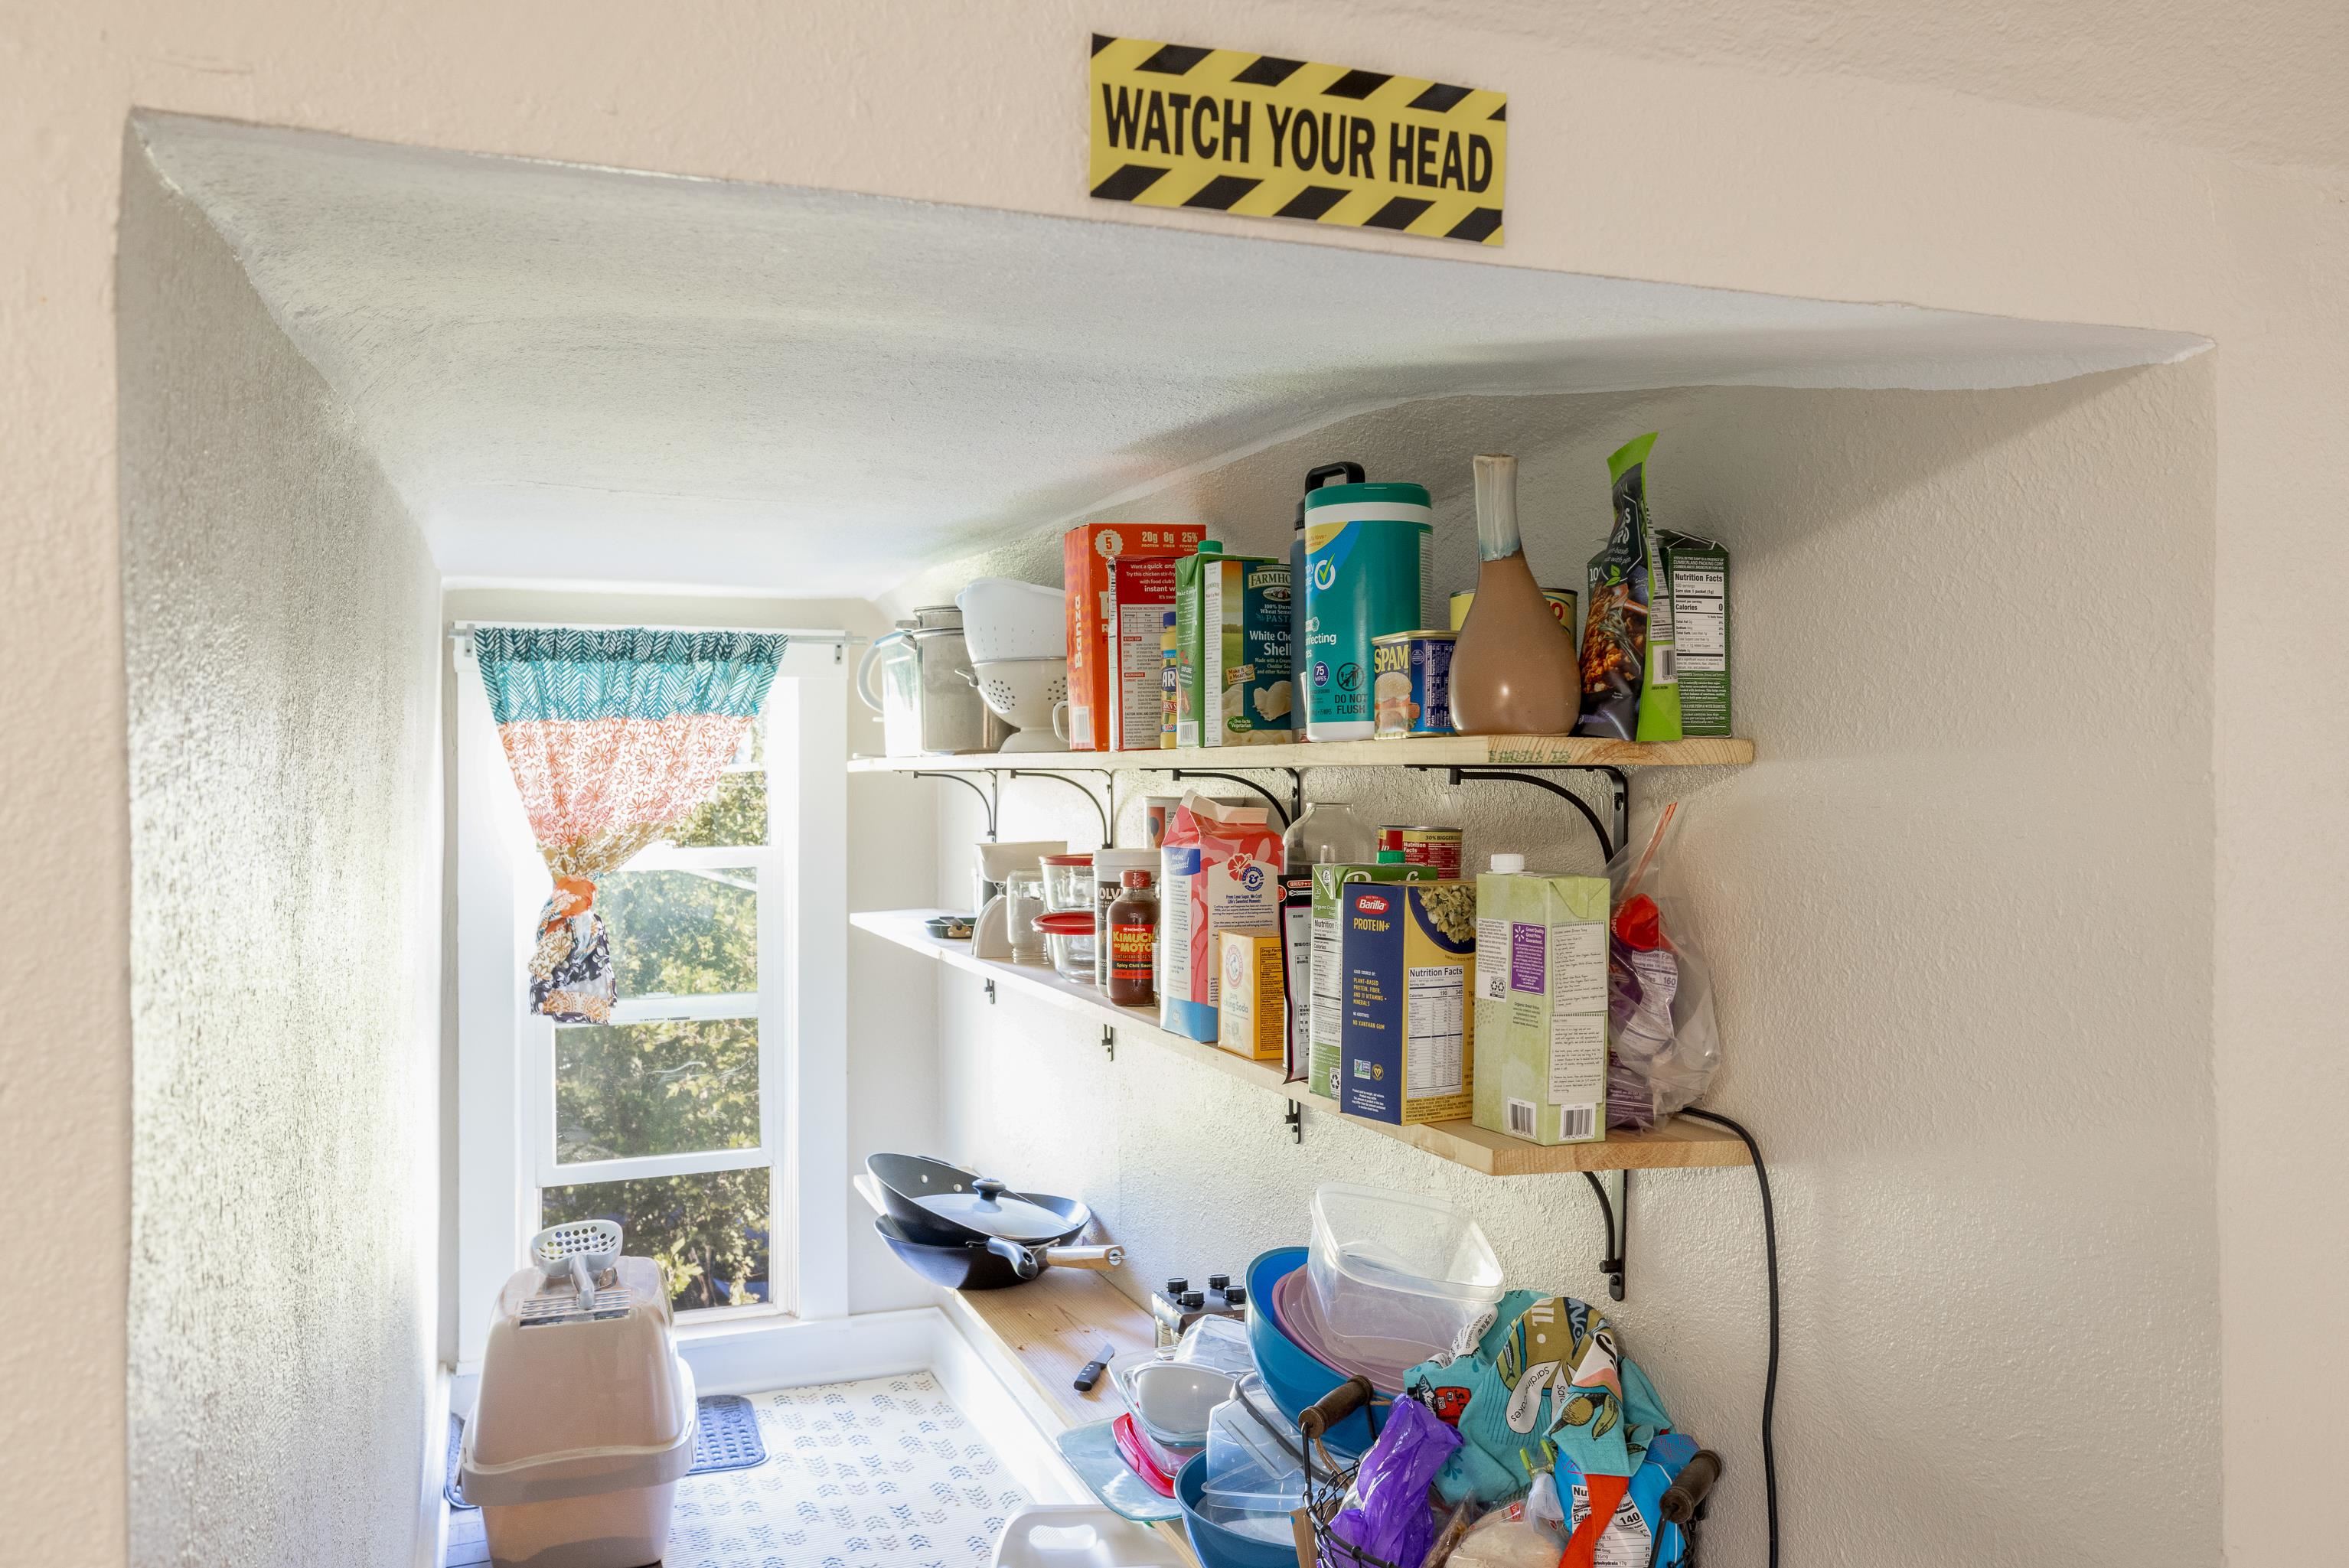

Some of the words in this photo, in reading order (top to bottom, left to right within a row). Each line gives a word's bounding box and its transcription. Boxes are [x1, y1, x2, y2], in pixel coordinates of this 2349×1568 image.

[1101, 82, 1251, 164] WATCH
[1266, 103, 1376, 180] YOUR
[1389, 122, 1493, 194] HEAD
[1105, 537, 1112, 549] 5
[1141, 531, 1159, 544] 20g
[1163, 531, 1174, 544] 8g
[1182, 532, 1198, 543] 25%
[1251, 572, 1291, 587] FARMHO
[1675, 573, 1704, 582] Nutrition
[1705, 574, 1723, 582] Facts
[1718, 603, 1724, 611] 0
[1075, 594, 1083, 669] Banza
[1249, 630, 1275, 641] White
[1264, 643, 1291, 656] Shell
[1374, 644, 1409, 673] SPAM
[1316, 665, 1325, 676] 75
[1162, 670, 1176, 687] AR
[1334, 693, 1346, 704] DO
[1349, 693, 1368, 703] NOT
[1336, 704, 1366, 715] FLUSH
[1248, 874, 1259, 885] &
[1359, 898, 1385, 911] Barilla
[1314, 919, 1335, 929] Nutrition
[1353, 918, 1390, 932] PROTEIN+
[1112, 931, 1154, 943] KIMUCH
[1120, 942, 1152, 953] MOTO
[1409, 968, 1443, 977] Nutrition
[1444, 967, 1463, 976] Facts
[1353, 977, 1379, 986] PLANT-BASED
[1663, 976, 1676, 986] 160
[1353, 984, 1369, 993] PROTEIN,
[1236, 1001, 1249, 1013] Soda
[1358, 1020, 1376, 1028] XANTHAN
[1620, 1511, 1641, 1525] 140
